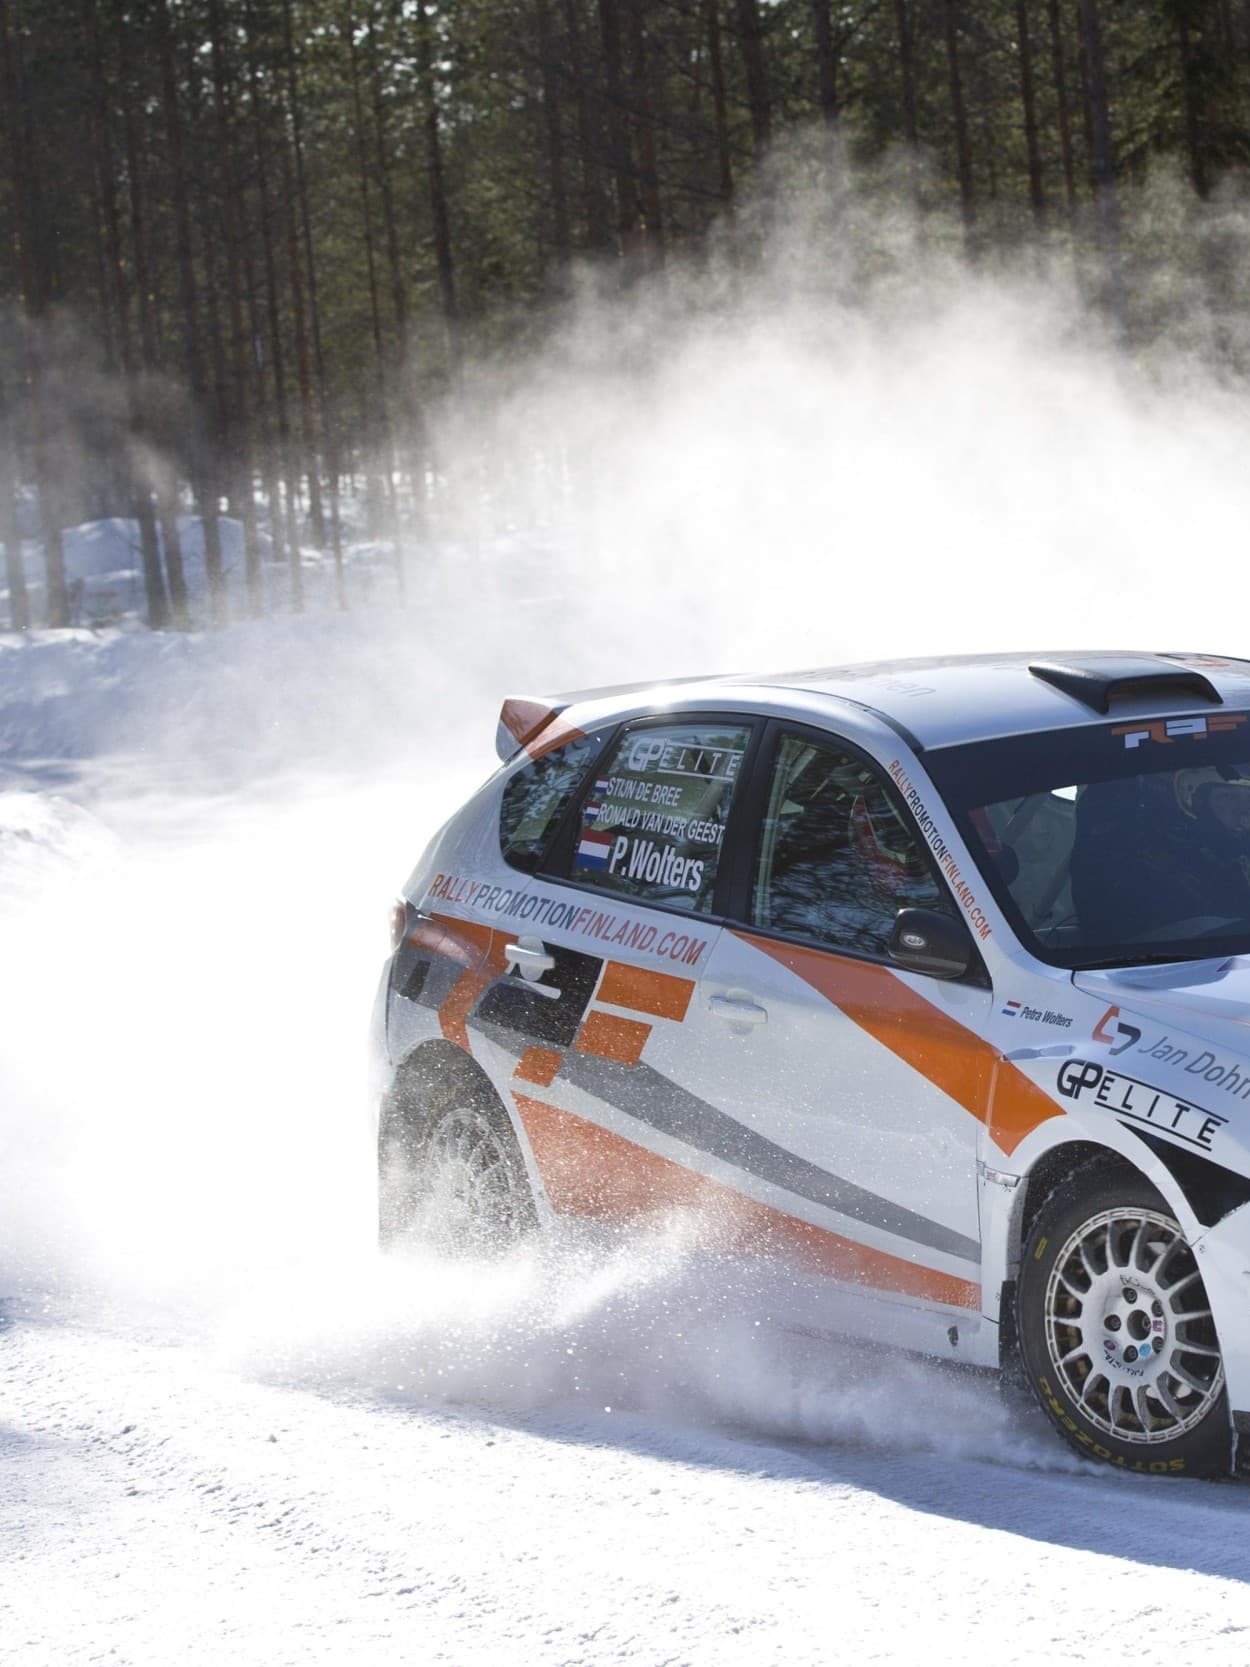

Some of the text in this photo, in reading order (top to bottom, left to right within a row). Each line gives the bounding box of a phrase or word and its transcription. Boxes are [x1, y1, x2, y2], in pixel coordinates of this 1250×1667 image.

[606, 777, 683, 807] STIJN DE BREE
[597, 803, 726, 844] RONALD VAN DER GEEST
[888, 759, 993, 941] RALLYPROMOTIONFINLAND.COM
[427, 873, 707, 966] RALLYPROMOTIONFINLAND.COM
[1019, 1006, 1073, 1028] Petra Wolters
[1138, 1036, 1187, 1066] Jan
